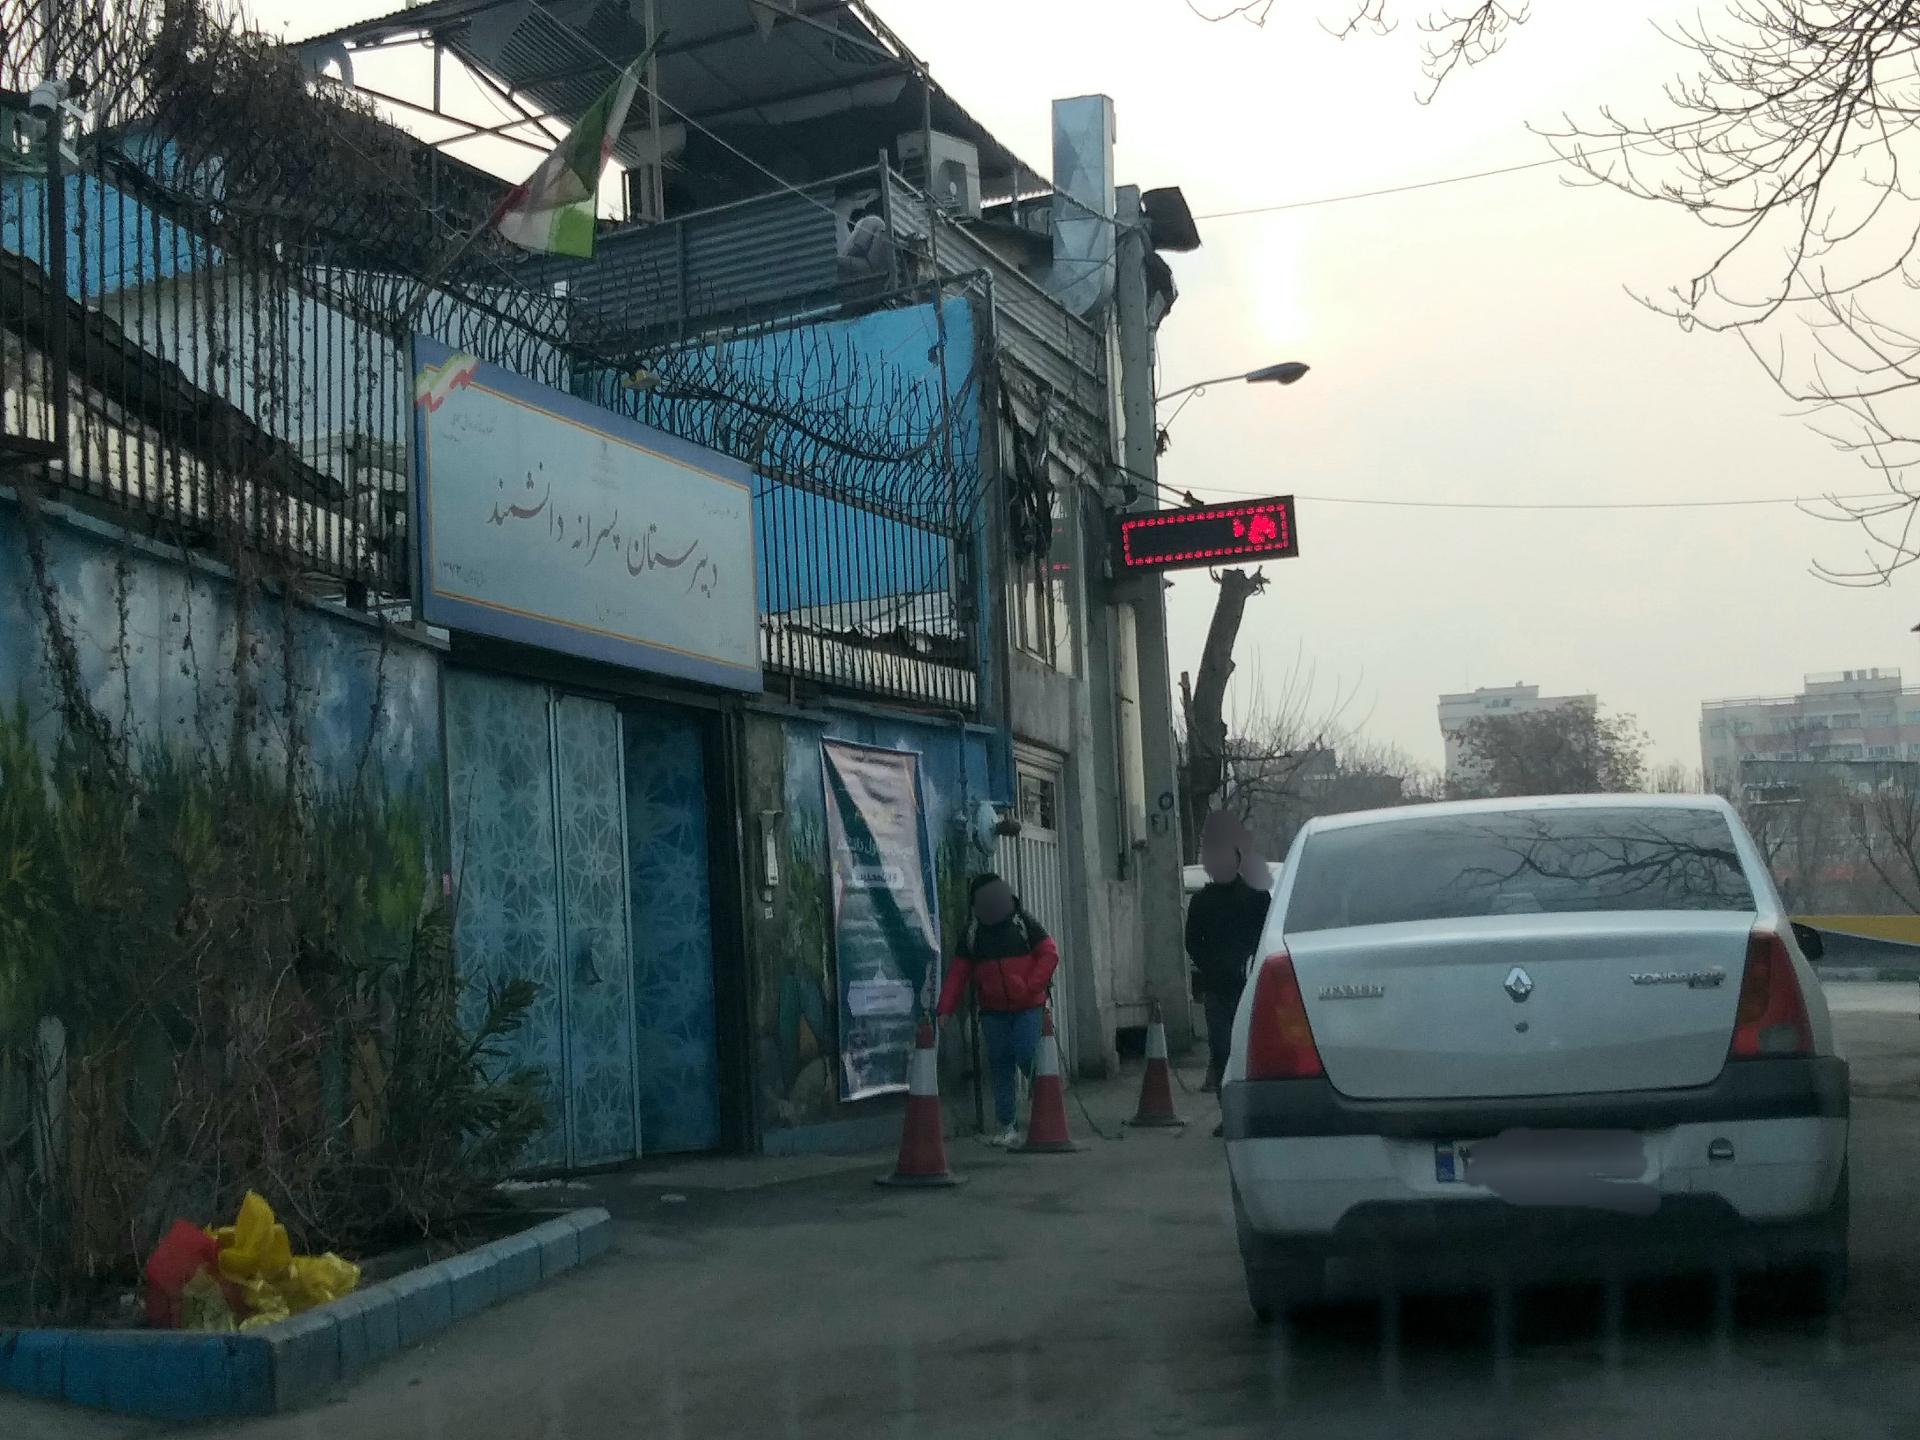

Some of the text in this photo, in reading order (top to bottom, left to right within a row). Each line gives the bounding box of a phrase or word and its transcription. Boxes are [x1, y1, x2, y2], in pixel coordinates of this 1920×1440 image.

[485, 460, 719, 600] دبیرستان پسرانه دانشمند
